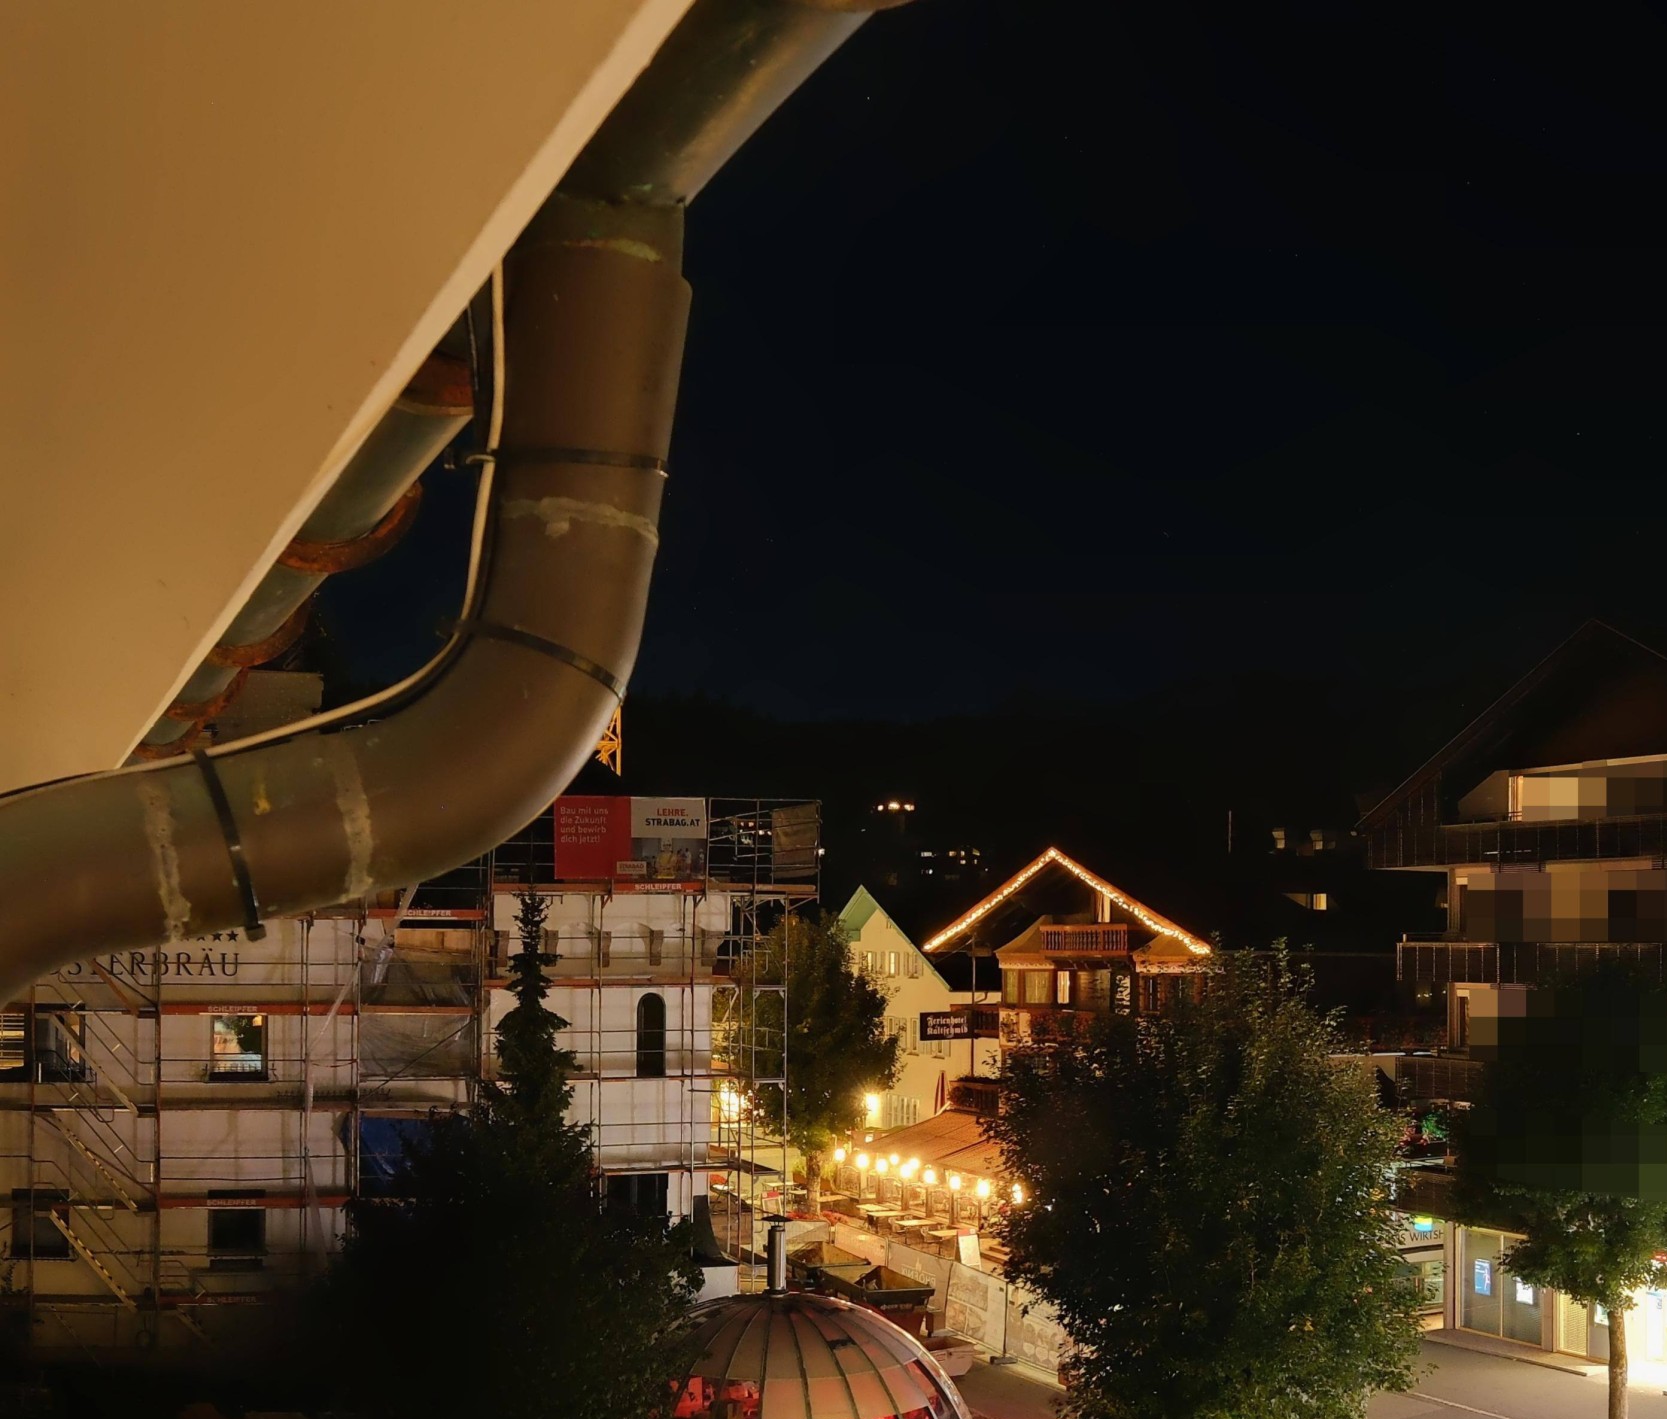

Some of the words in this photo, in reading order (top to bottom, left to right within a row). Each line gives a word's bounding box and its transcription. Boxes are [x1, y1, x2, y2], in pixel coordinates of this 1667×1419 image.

[560, 807, 576, 815] Bau
[656, 808, 688, 817] LEHRE.
[560, 816, 573, 824] die
[574, 816, 607, 824] Zukunft
[645, 818, 700, 827] STRABAG.AT
[560, 826, 576, 834] und
[578, 826, 607, 834] bewirb
[560, 835, 577, 843] dich
[634, 883, 682, 891] SCHLEIPFER
[404, 909, 452, 917] CHLEPFER
[207, 1005, 258, 1013] SCHLEIPFER
